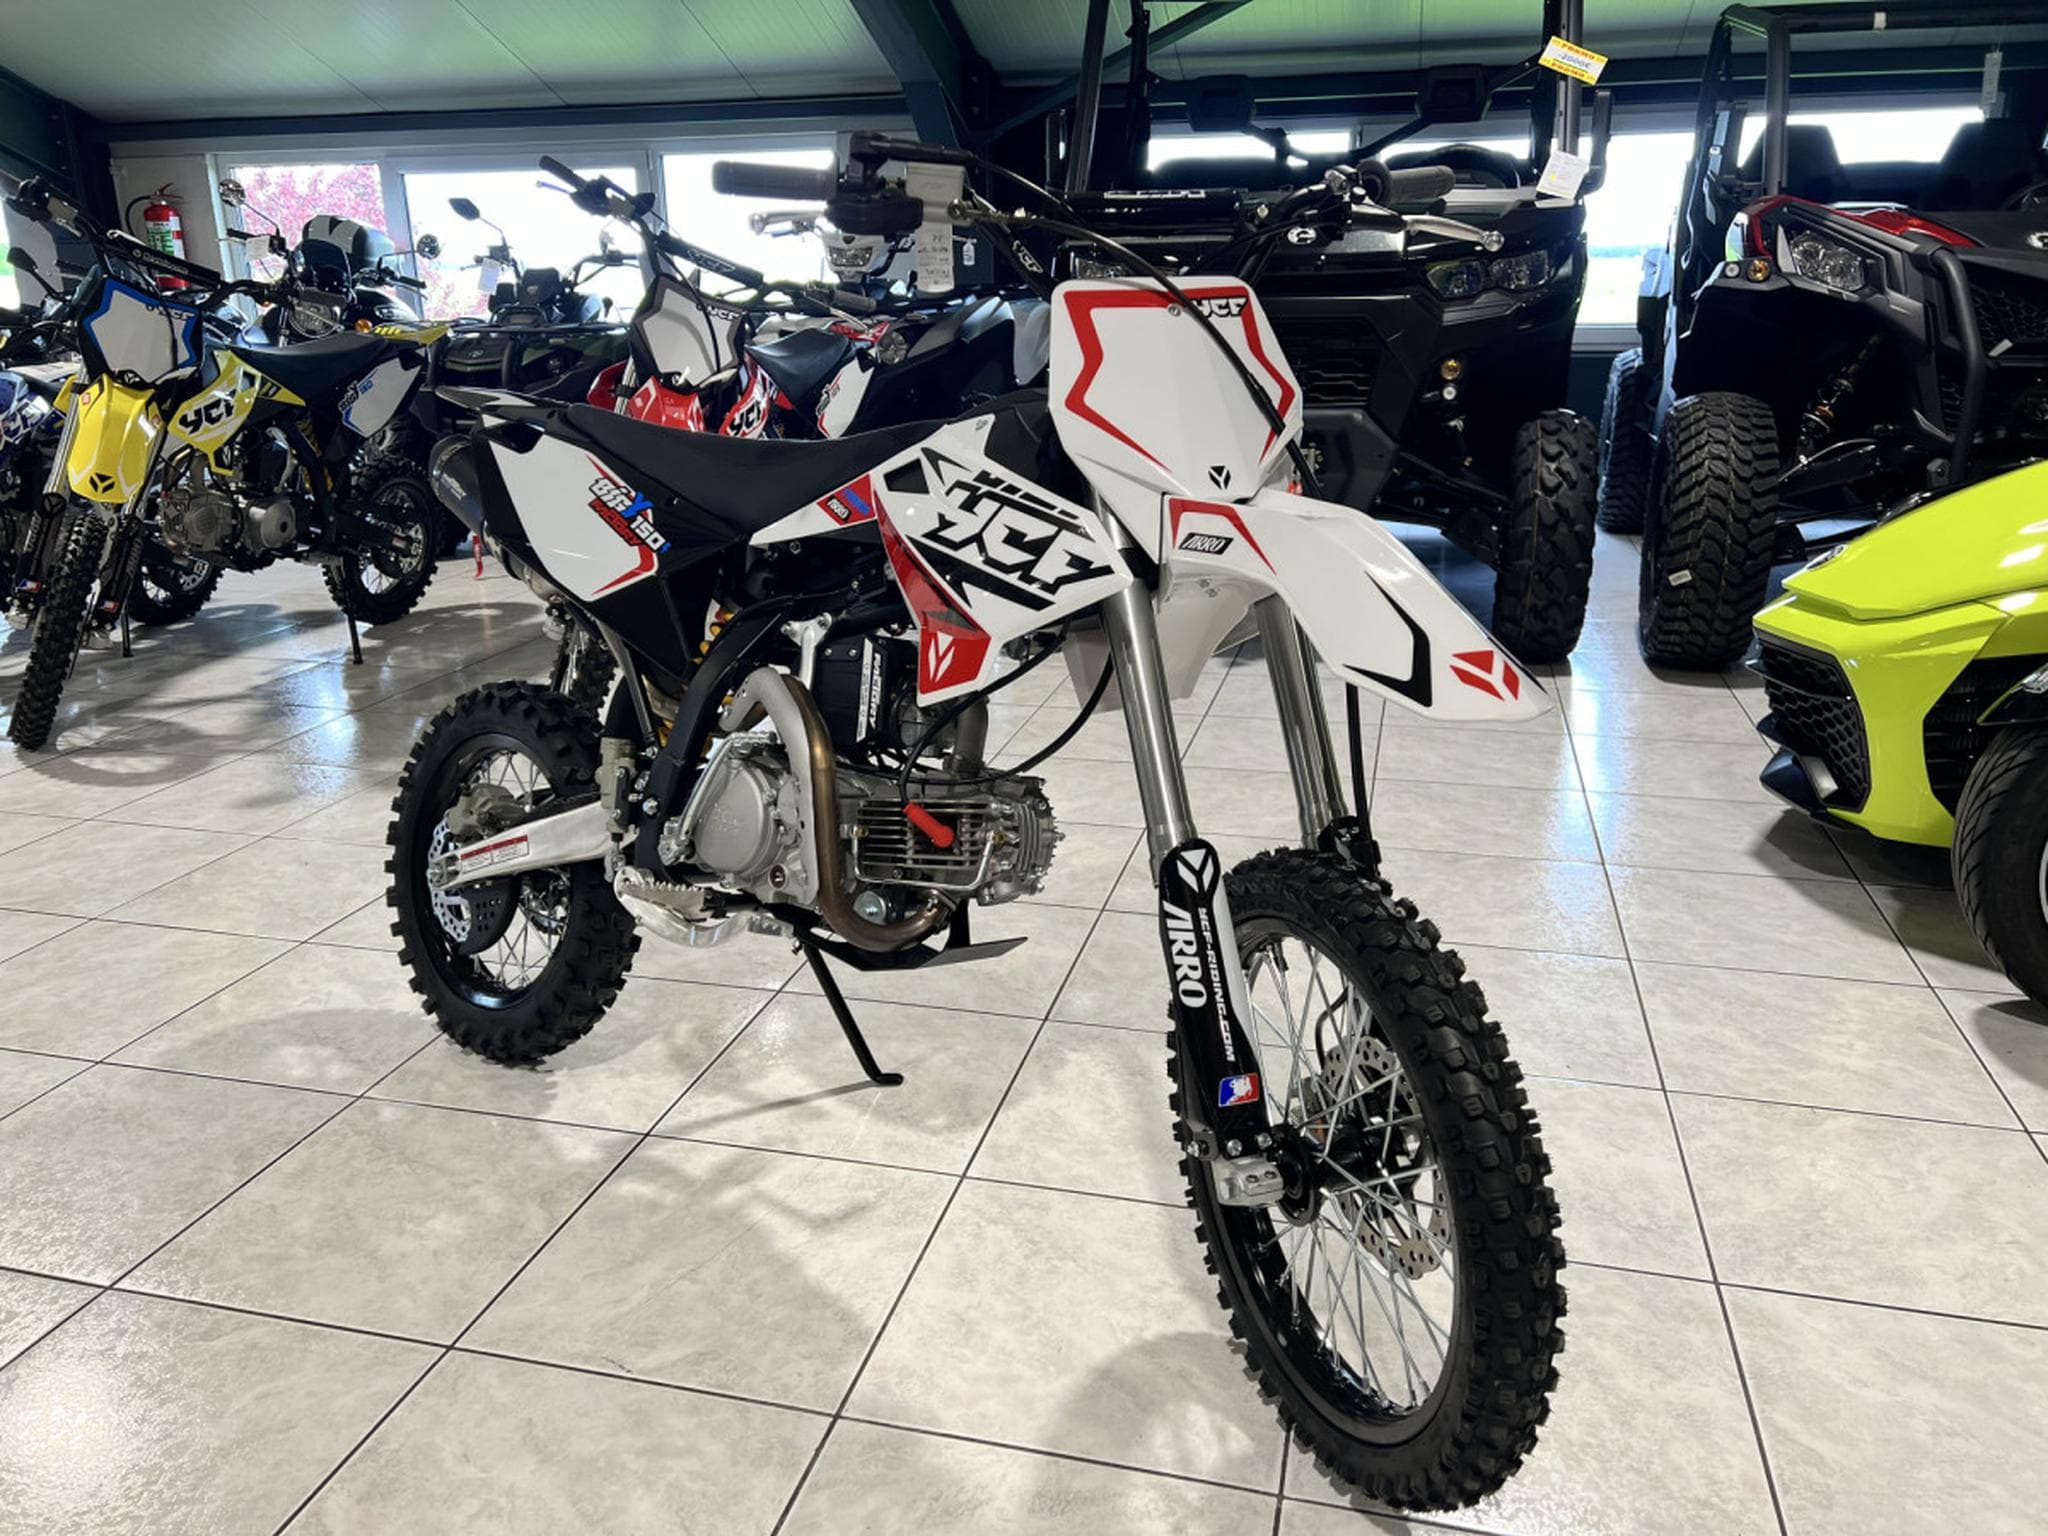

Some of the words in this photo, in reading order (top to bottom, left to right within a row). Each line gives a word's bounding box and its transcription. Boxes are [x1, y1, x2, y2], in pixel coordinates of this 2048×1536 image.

[1191, 297, 1247, 318] YCF
[630, 515, 667, 551] 150
[921, 480, 1114, 596] YCF
[1182, 534, 1226, 552] ARRO
[868, 652, 882, 729] FACTORY
[1162, 900, 1208, 1008] ARRO
[1198, 906, 1236, 1062] YCF-RIDING.COM
